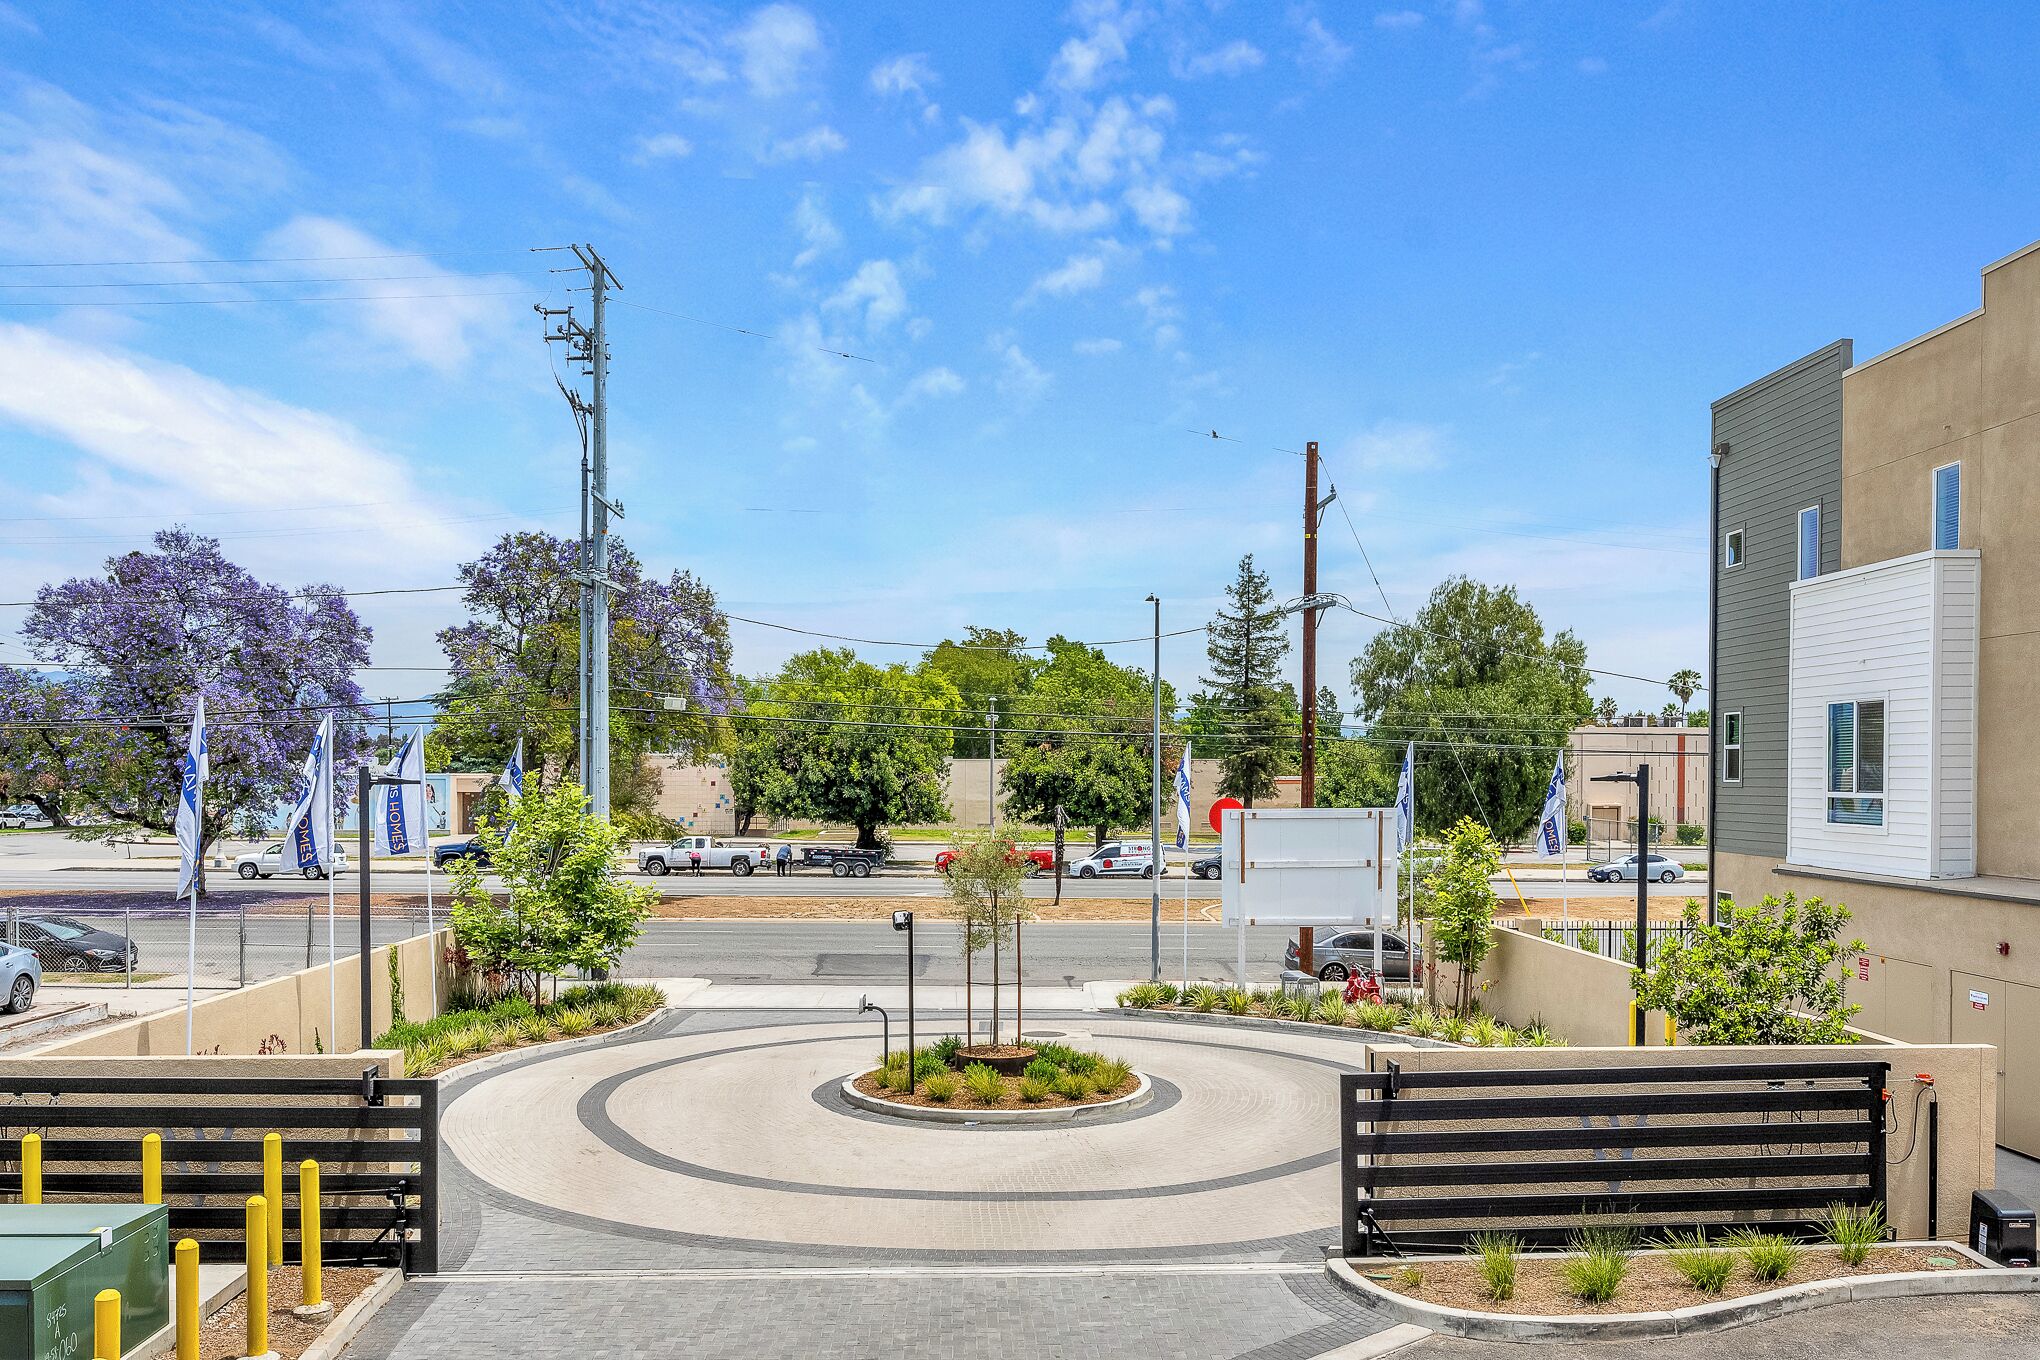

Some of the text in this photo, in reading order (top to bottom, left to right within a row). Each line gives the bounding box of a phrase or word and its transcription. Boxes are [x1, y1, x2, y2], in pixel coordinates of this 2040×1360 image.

[298, 816, 314, 863] OMES
[389, 801, 404, 850] HOMES
[1545, 821, 1559, 852] OMES
